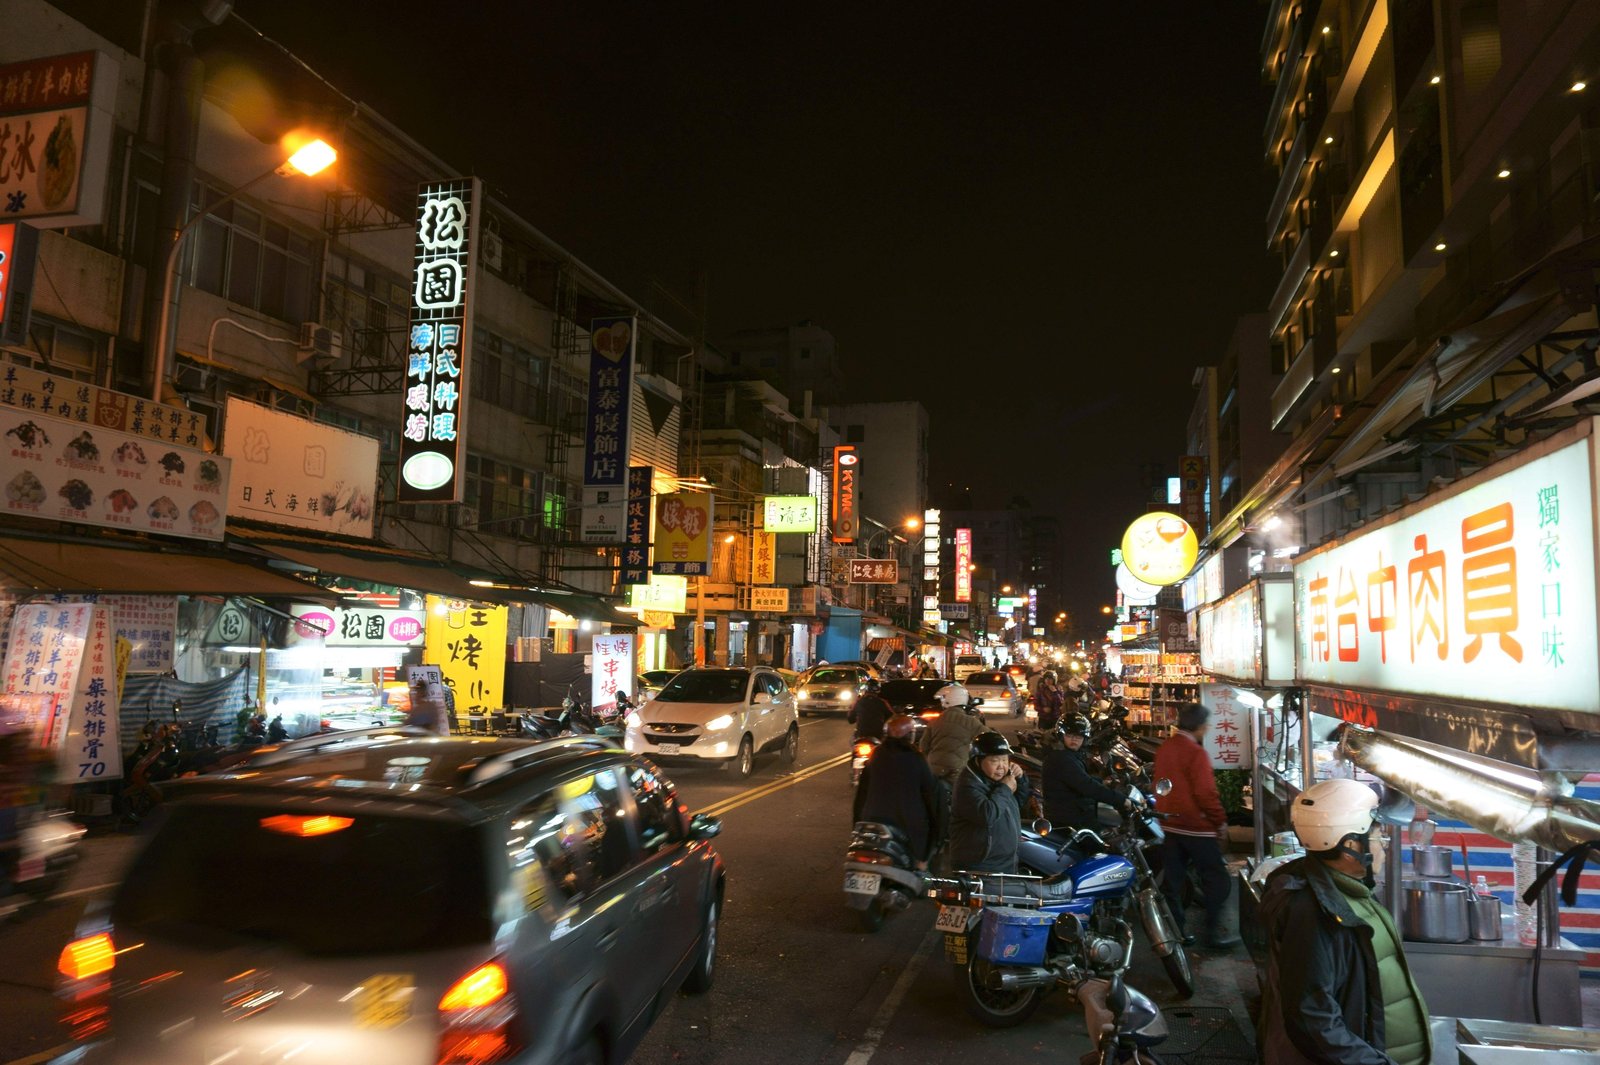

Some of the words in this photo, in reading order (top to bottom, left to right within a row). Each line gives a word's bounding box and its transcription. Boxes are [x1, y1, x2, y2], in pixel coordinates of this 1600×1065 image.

[415, 197, 466, 309] 松園
[404, 323, 433, 442] 海鮮碳烤
[432, 323, 460, 440] 日式料理
[242, 486, 320, 515] 日式海鮮
[840, 469, 854, 534] KYMCO
[1308, 501, 1524, 665] 南台中肉員
[1536, 483, 1565, 669] 獨家口味
[340, 613, 386, 640] 松園
[392, 621, 418, 637] 日本料理
[82, 677, 107, 760] 藥燉排骨
[79, 761, 106, 778] 70
